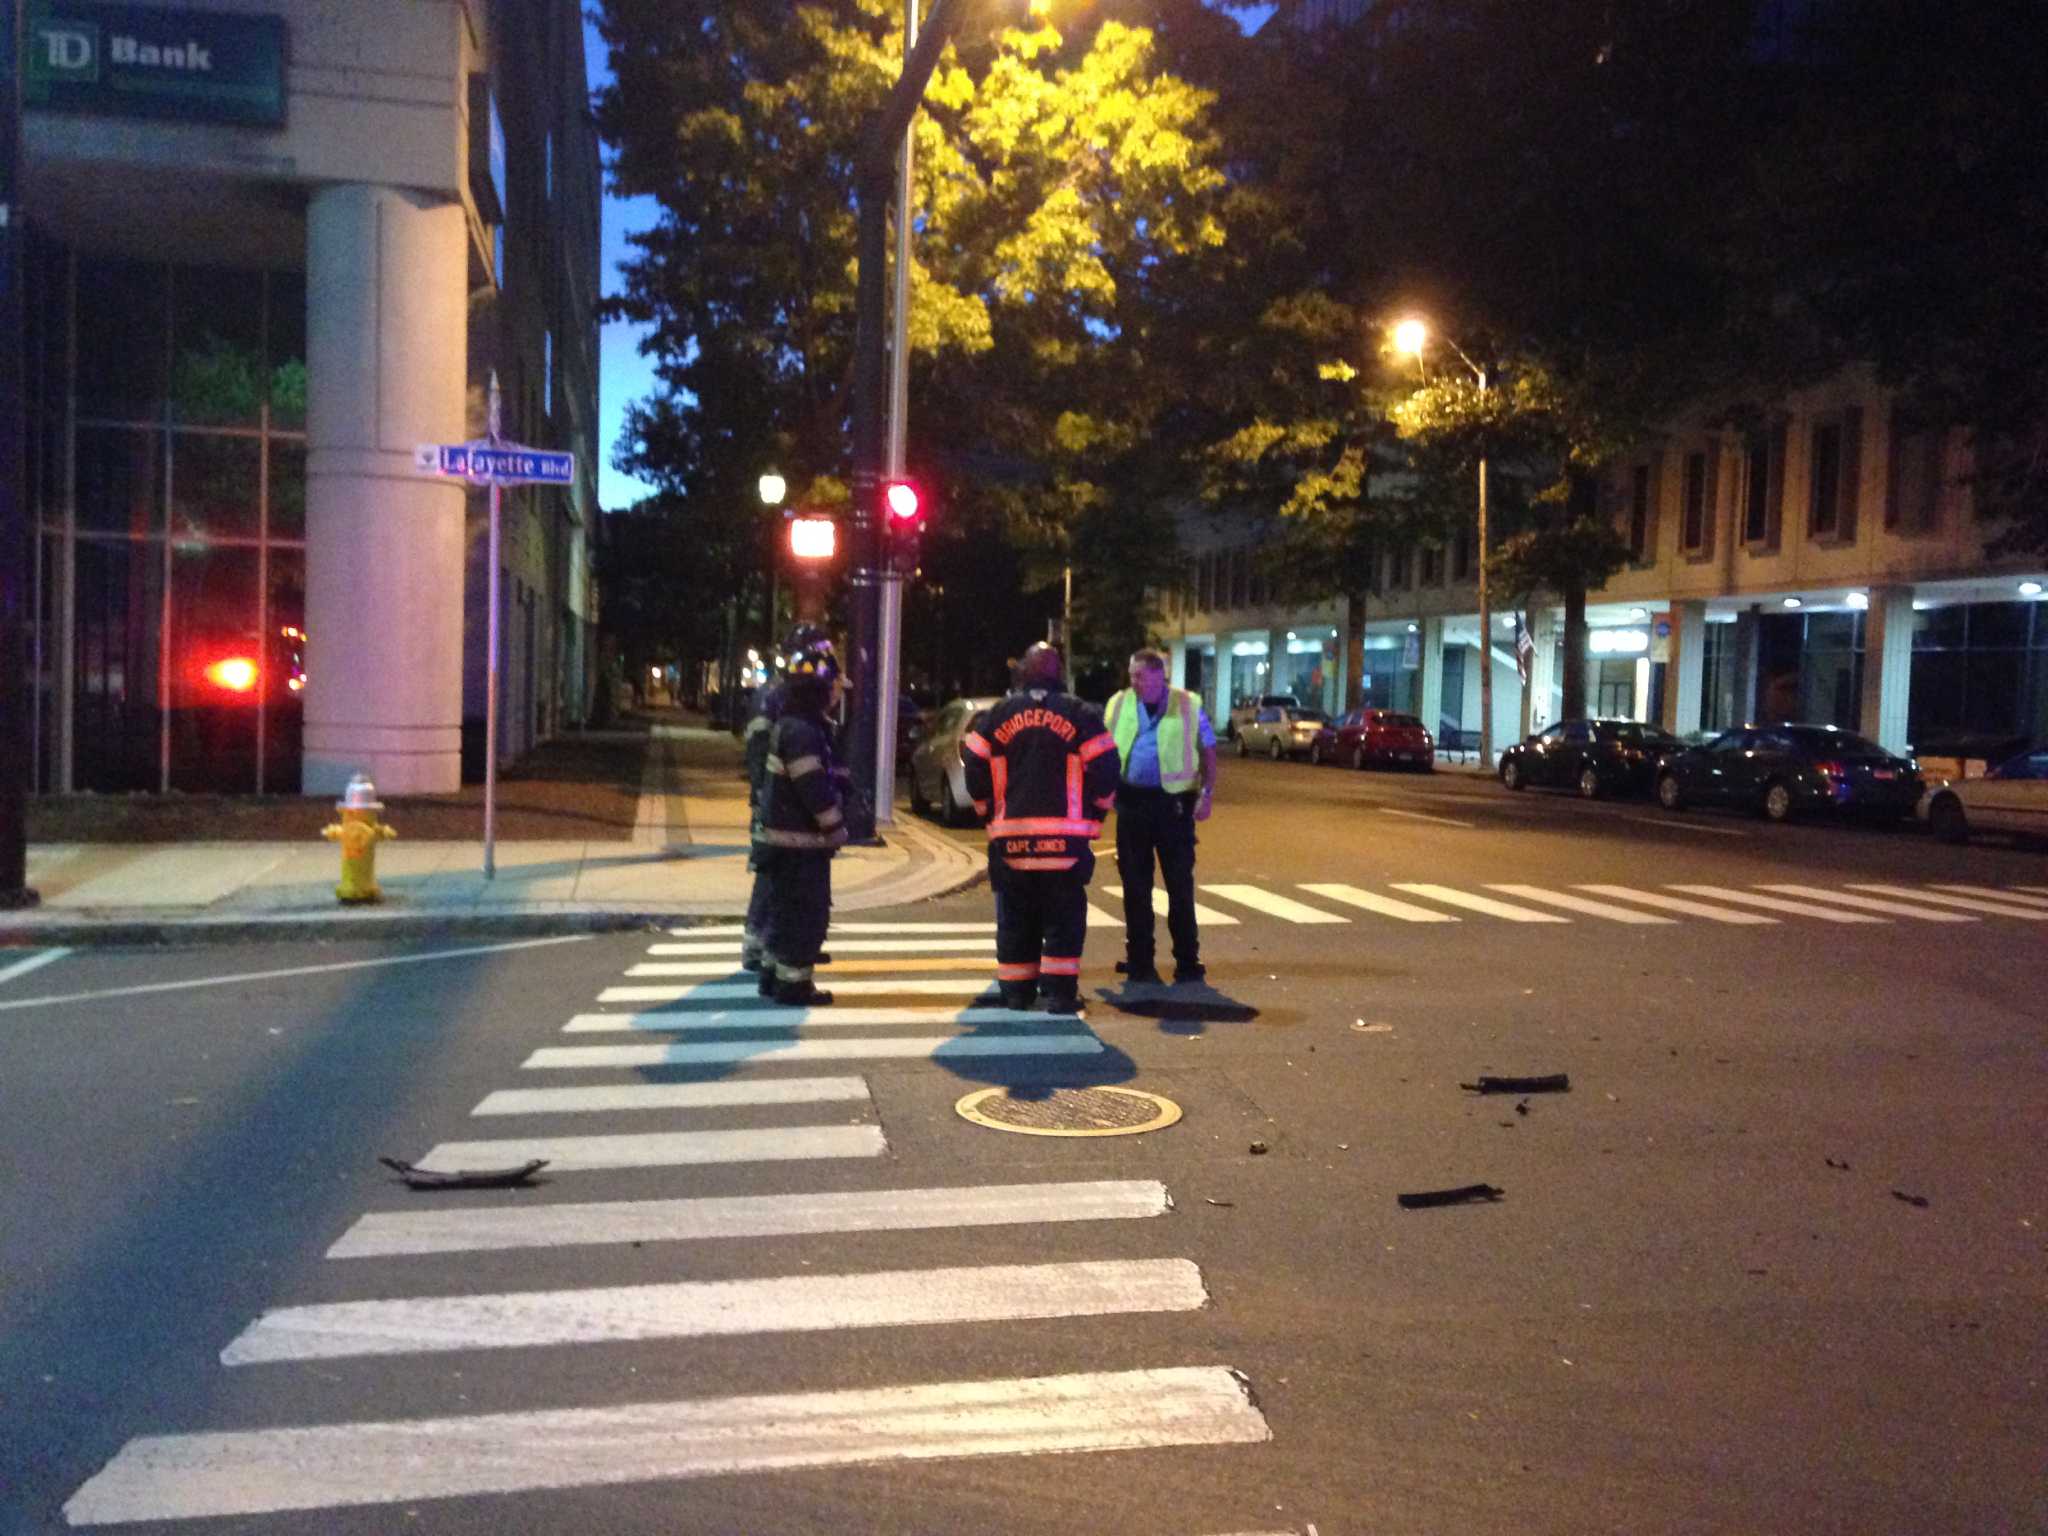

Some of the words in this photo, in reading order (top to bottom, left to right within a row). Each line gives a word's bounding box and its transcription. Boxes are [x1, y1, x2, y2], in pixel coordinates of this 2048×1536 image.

[40, 30, 91, 69] TD
[111, 36, 211, 71] Bank
[443, 447, 534, 478] Lafayette
[540, 458, 569, 477] Blvd
[994, 708, 1077, 744] BRIDGEPORT
